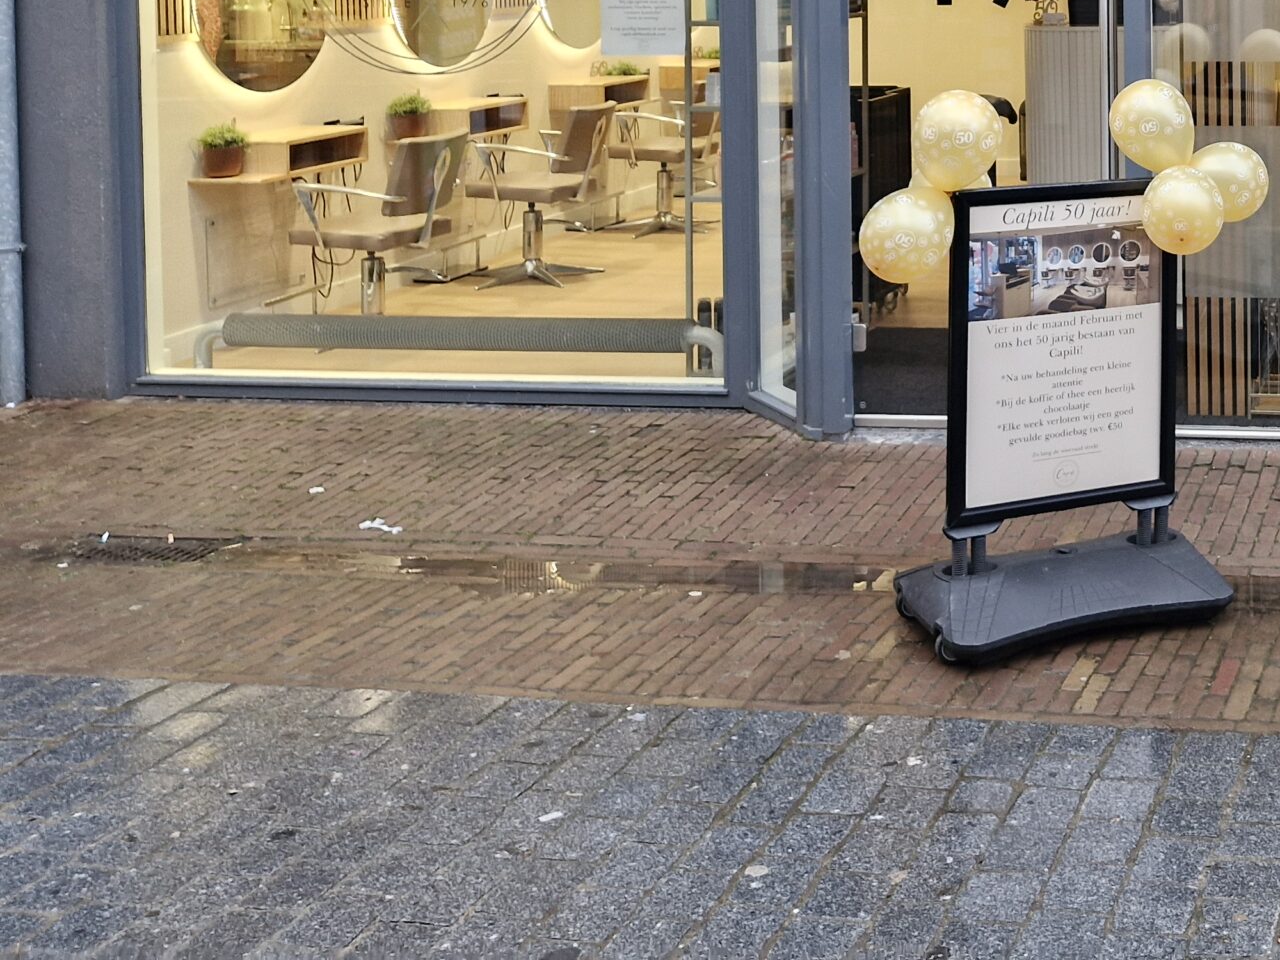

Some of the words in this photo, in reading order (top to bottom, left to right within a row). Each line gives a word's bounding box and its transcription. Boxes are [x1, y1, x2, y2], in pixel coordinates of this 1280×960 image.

[955, 132, 974, 144] 50
[1002, 205, 1055, 230] Capili
[1061, 202, 1085, 221] 50
[1087, 200, 1132, 225] jaar!
[986, 324, 1008, 335] Vier
[1012, 322, 1023, 332] in
[1026, 320, 1039, 331] de
[1042, 317, 1076, 329] maand
[1080, 312, 1122, 326] Februari
[1125, 311, 1144, 320] met
[994, 339, 1013, 349] ons
[1016, 336, 1032, 347] het
[1035, 335, 1049, 345] 50
[1050, 332, 1075, 347] jarig
[1078, 327, 1115, 340] bestaan
[1118, 327, 1135, 335] van
[1049, 345, 1084, 360] Capili!
[1035, 365, 1088, 379] behandeling
[1090, 364, 1105, 372] een
[1107, 360, 1132, 371] kleine
[1051, 379, 1084, 389] attentie
[1016, 396, 1027, 406] de
[1029, 392, 1054, 404] koffie
[1056, 390, 1066, 400] of
[1067, 389, 1086, 399] thee
[1043, 401, 1091, 415] chocolaatje
[1023, 419, 1044, 429] week
[1114, 407, 1134, 419] goed
[1044, 426, 1088, 441] goodiebag
